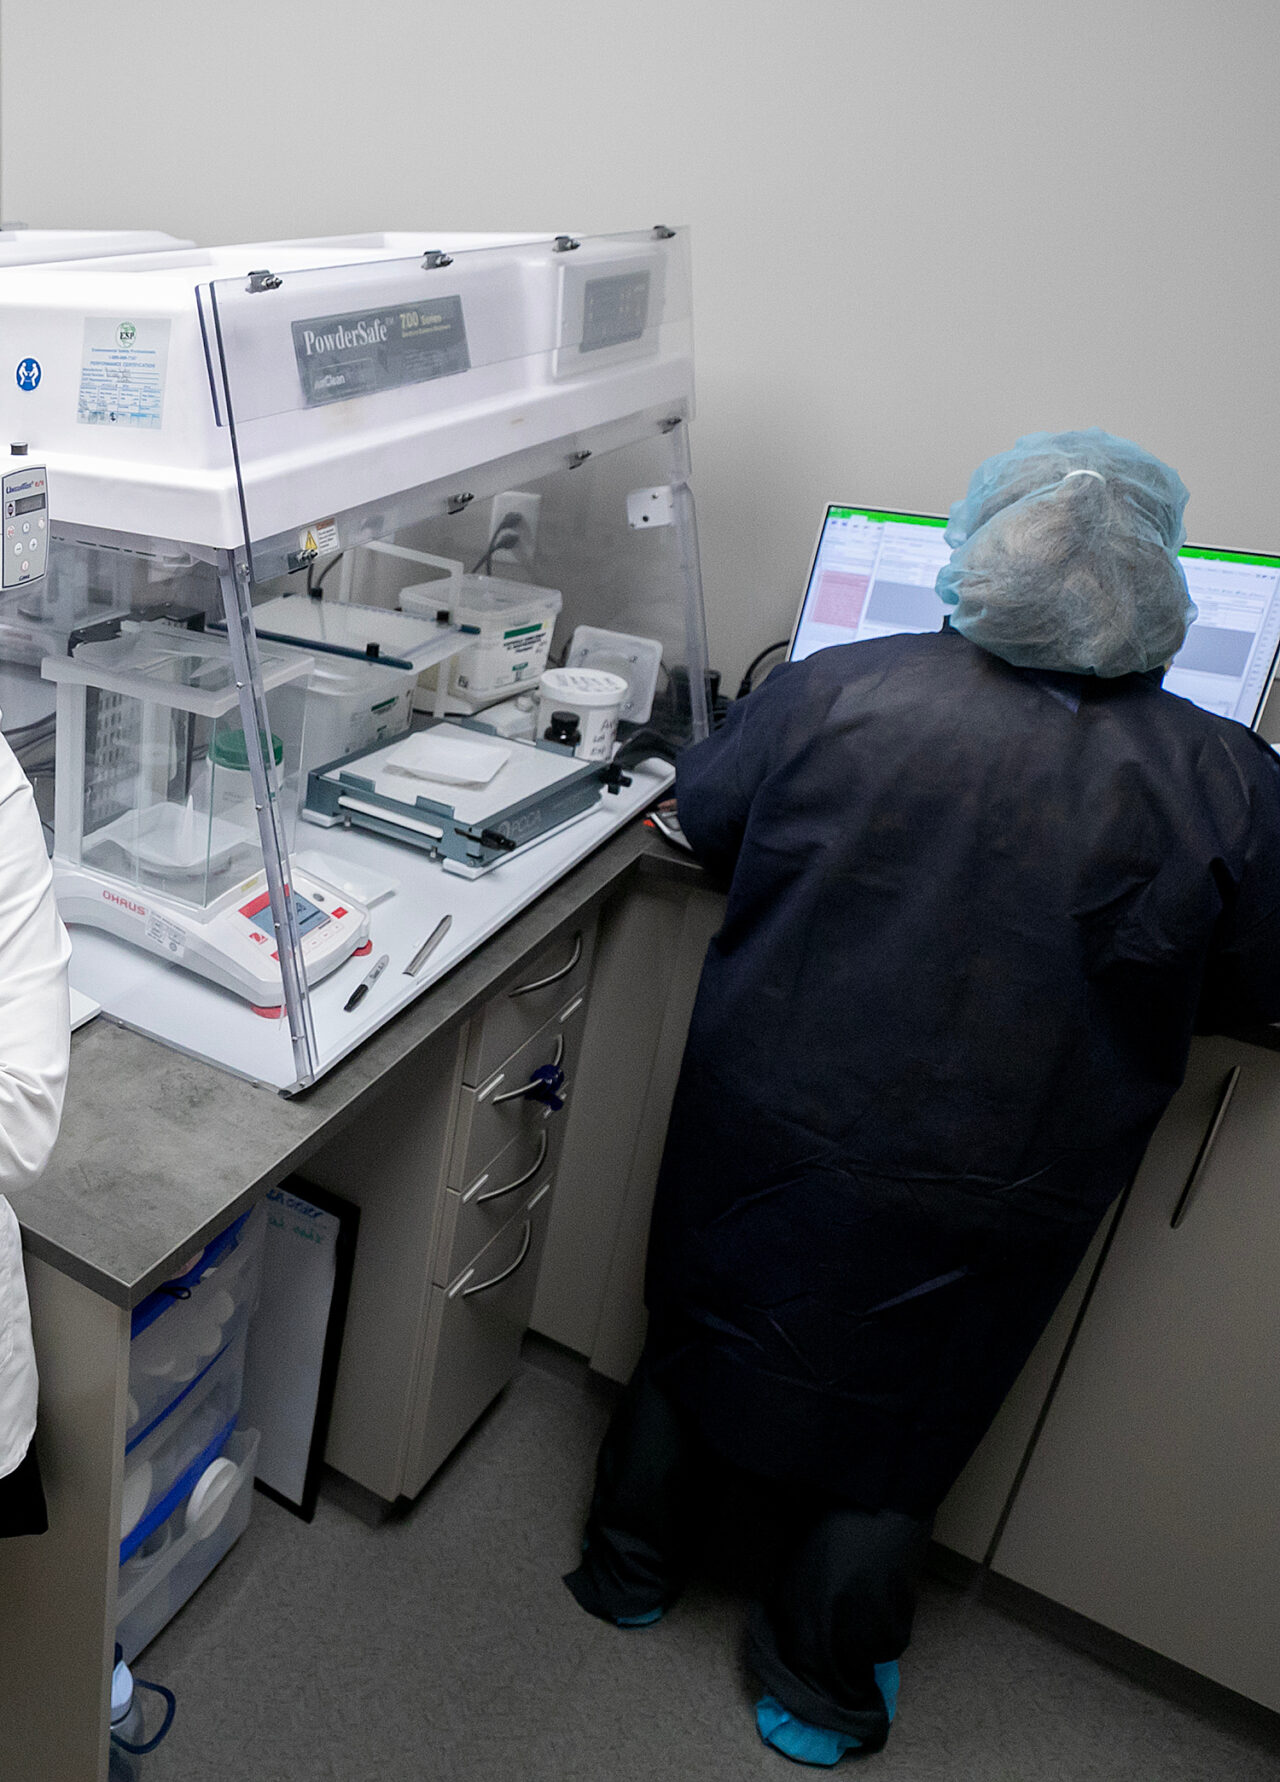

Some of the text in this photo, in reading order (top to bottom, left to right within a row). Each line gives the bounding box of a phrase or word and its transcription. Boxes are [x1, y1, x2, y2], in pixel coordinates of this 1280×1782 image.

[399, 311, 419, 329] 700
[119, 332, 135, 340] ESP
[102, 890, 146, 916] OHAUS
